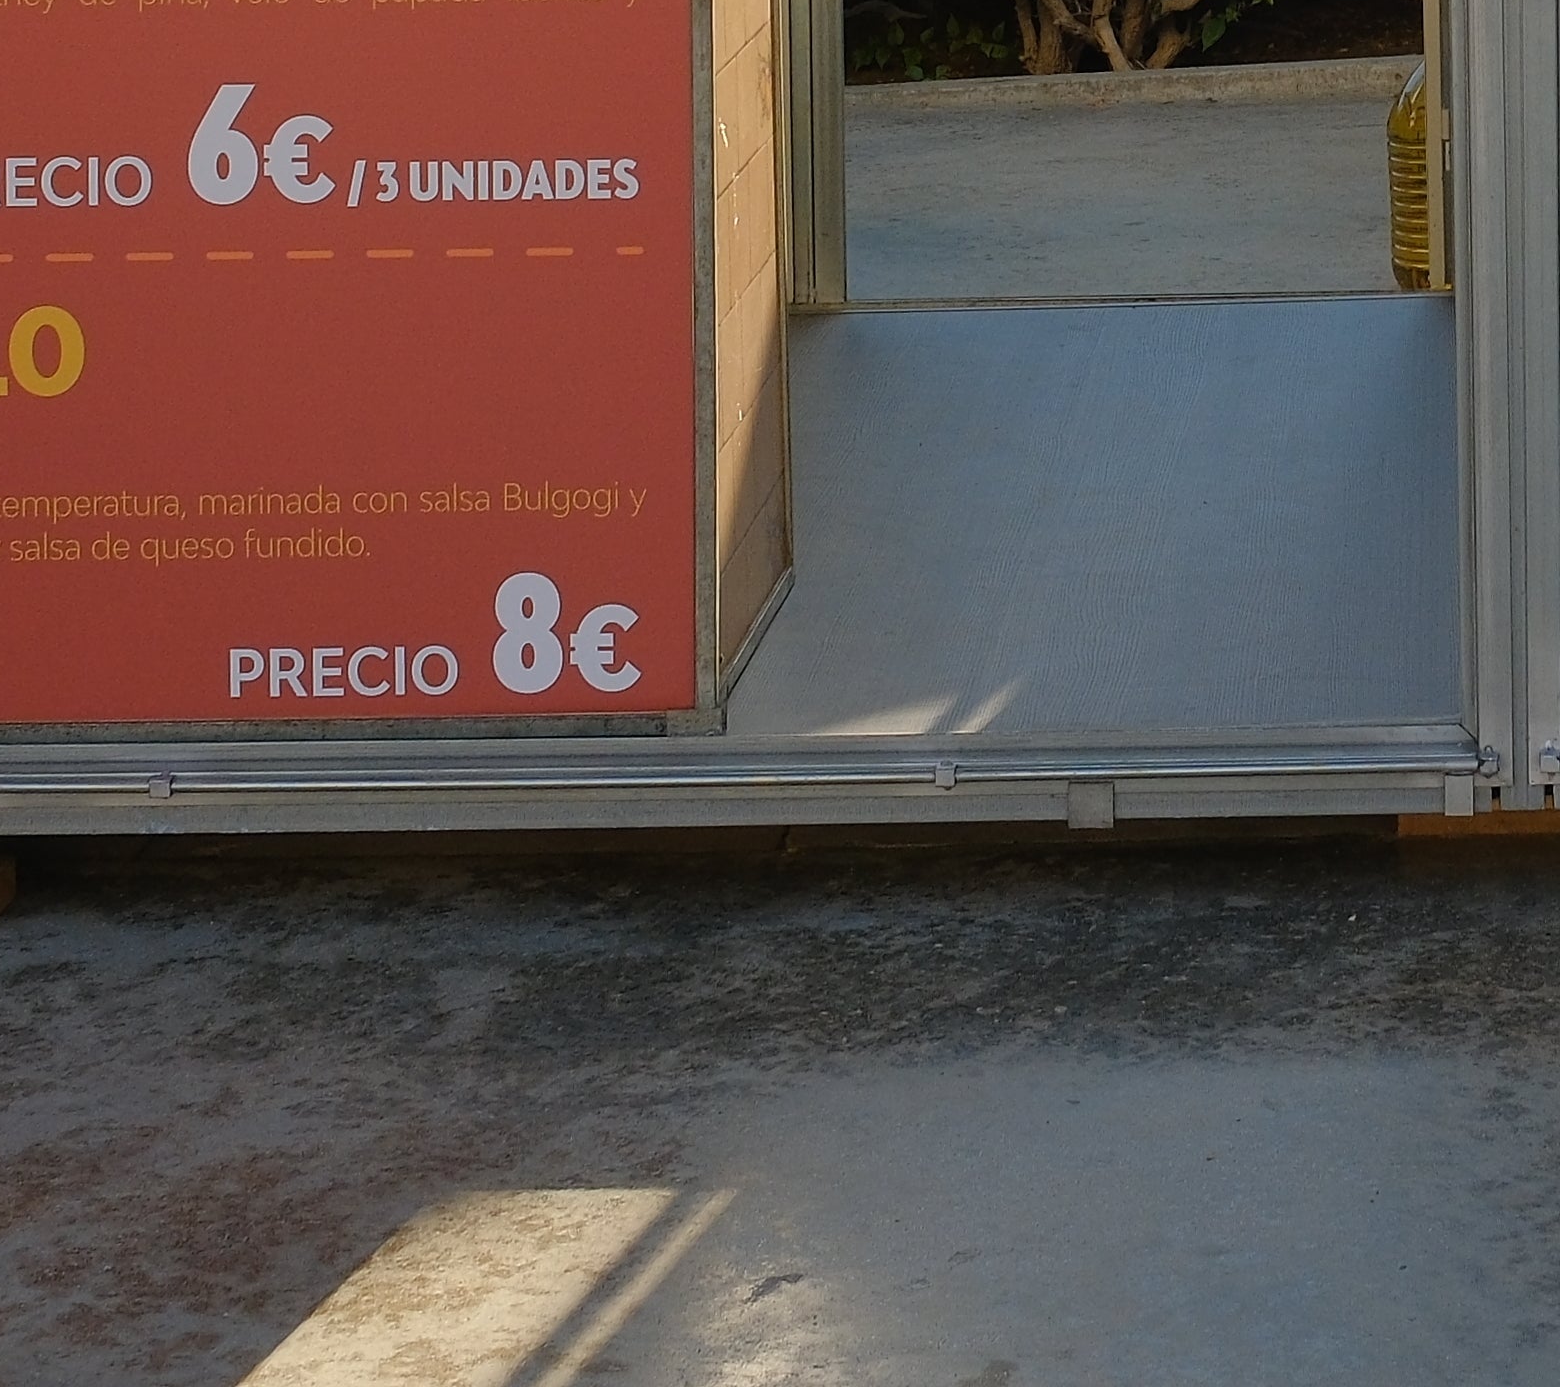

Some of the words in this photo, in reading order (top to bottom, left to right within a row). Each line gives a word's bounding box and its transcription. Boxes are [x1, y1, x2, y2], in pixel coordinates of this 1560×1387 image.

[186, 82, 337, 207] 6€
[408, 157, 640, 203] UNIDADES
[198, 484, 342, 517] marinada
[352, 491, 408, 514] con
[419, 482, 491, 513] salsa
[503, 479, 620, 520] Bulgogi
[628, 488, 648, 518] y
[9, 530, 82, 563] salsa
[90, 530, 131, 561] de
[139, 536, 235, 567] queso
[243, 526, 371, 559] fundido.
[228, 644, 460, 699] PRECIO
[491, 571, 642, 695] 8€
